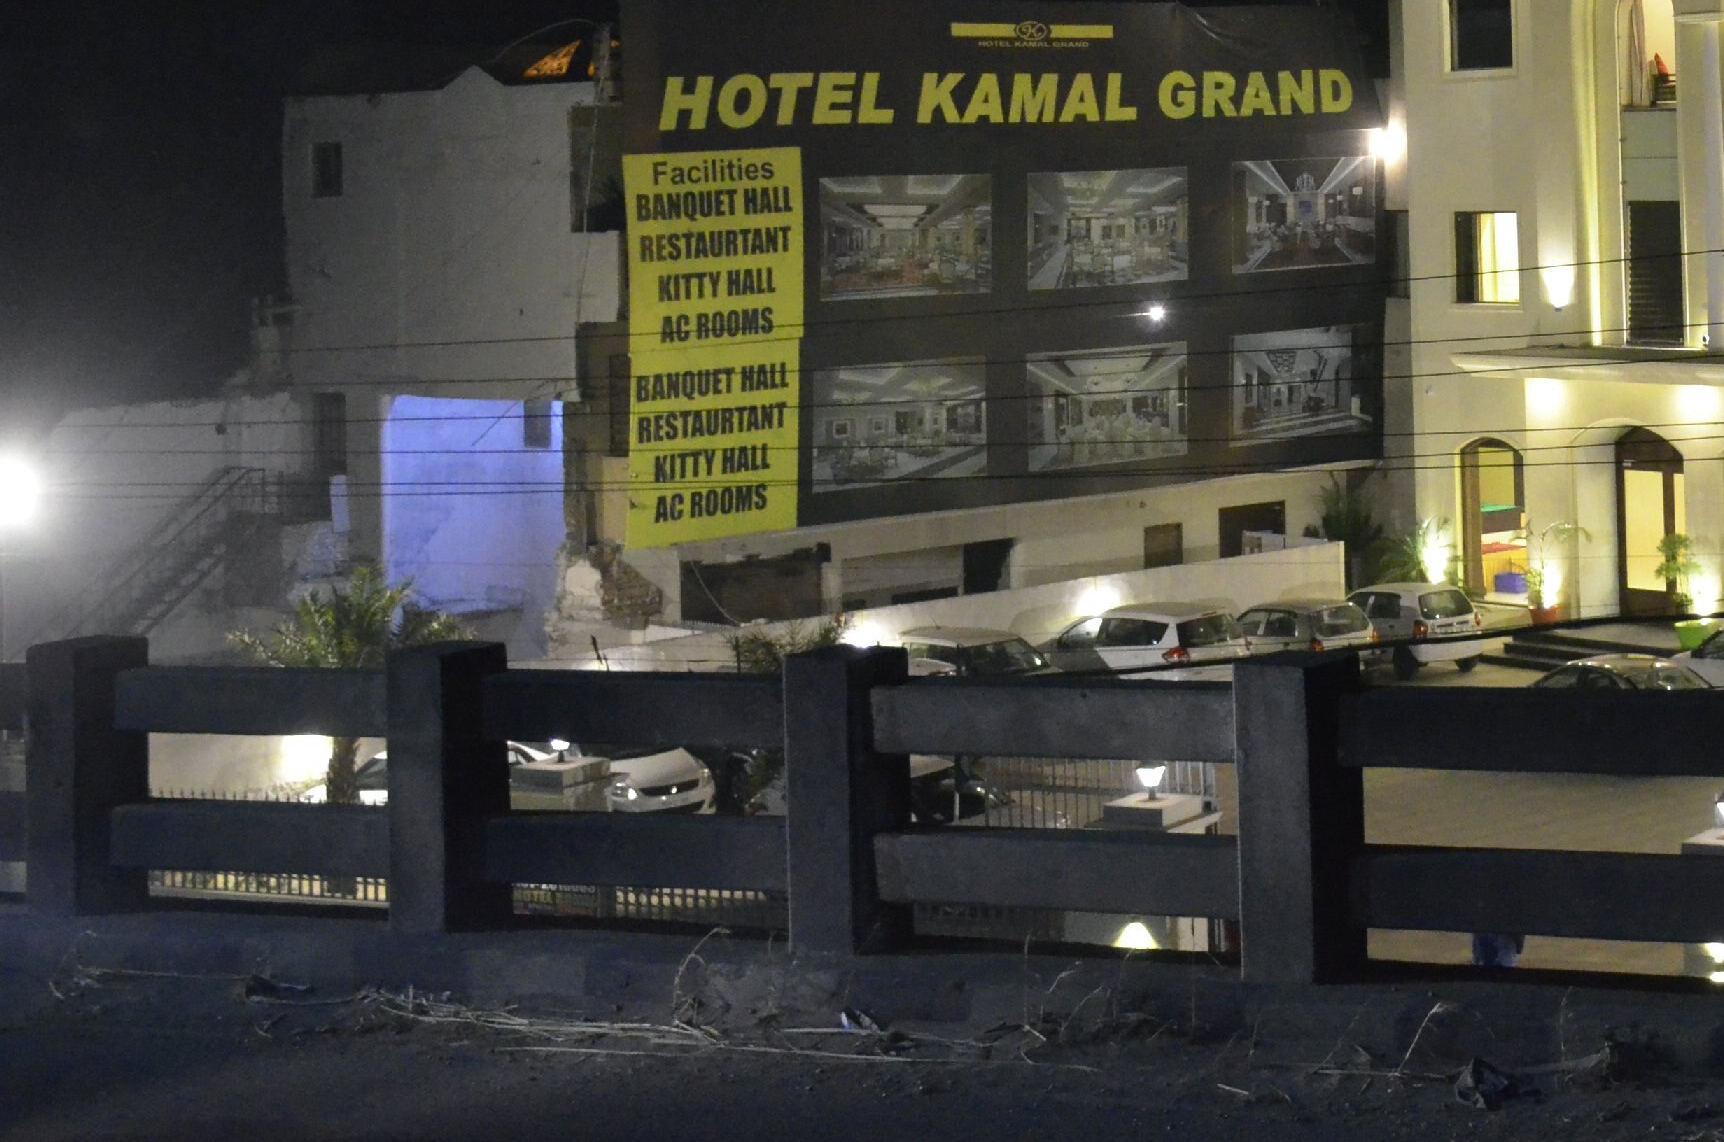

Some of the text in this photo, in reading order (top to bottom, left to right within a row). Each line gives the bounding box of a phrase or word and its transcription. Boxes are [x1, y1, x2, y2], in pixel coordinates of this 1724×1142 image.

[977, 40, 1012, 48] HOTEL
[1014, 40, 1050, 48] KAMAL
[658, 68, 1354, 131] HOTEL KAMAL GRAND
[652, 157, 775, 186] Facilities
[635, 186, 793, 222] BANQUET HALL
[639, 226, 792, 262] RESTAURTANT
[657, 266, 776, 302] KITTY HALL
[660, 306, 774, 344] AC ROOMS
[636, 362, 790, 403] BANQUET HALL
[638, 401, 788, 444] RESTAURTANT
[654, 443, 771, 483] KITTY HALL
[655, 483, 768, 524] AC ROOMS
